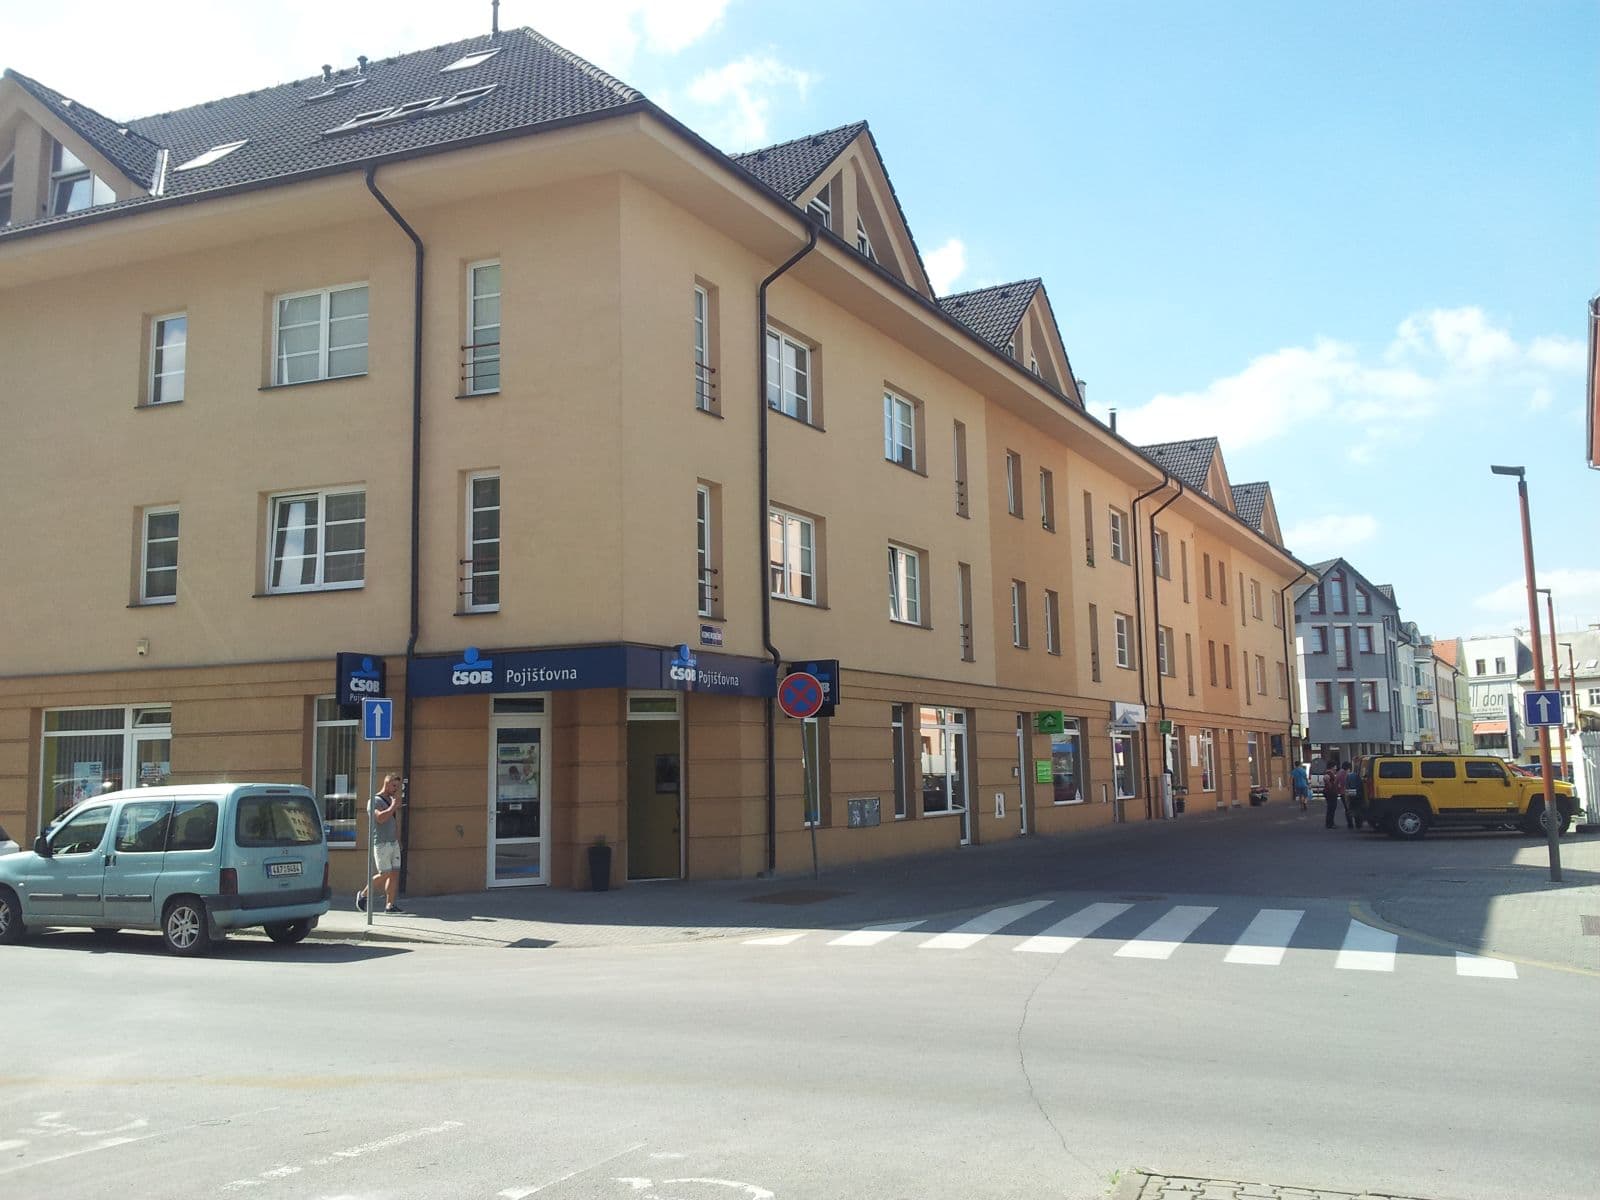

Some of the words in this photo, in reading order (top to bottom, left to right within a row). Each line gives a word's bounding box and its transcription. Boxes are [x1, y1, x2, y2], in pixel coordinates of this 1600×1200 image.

[350, 677, 380, 693] ČSOB
[452, 670, 493, 686] ČSOB
[506, 666, 577, 687] Pojišťovna
[670, 665, 697, 682] ČSOB
[698, 670, 739, 688] Pojišťovna
